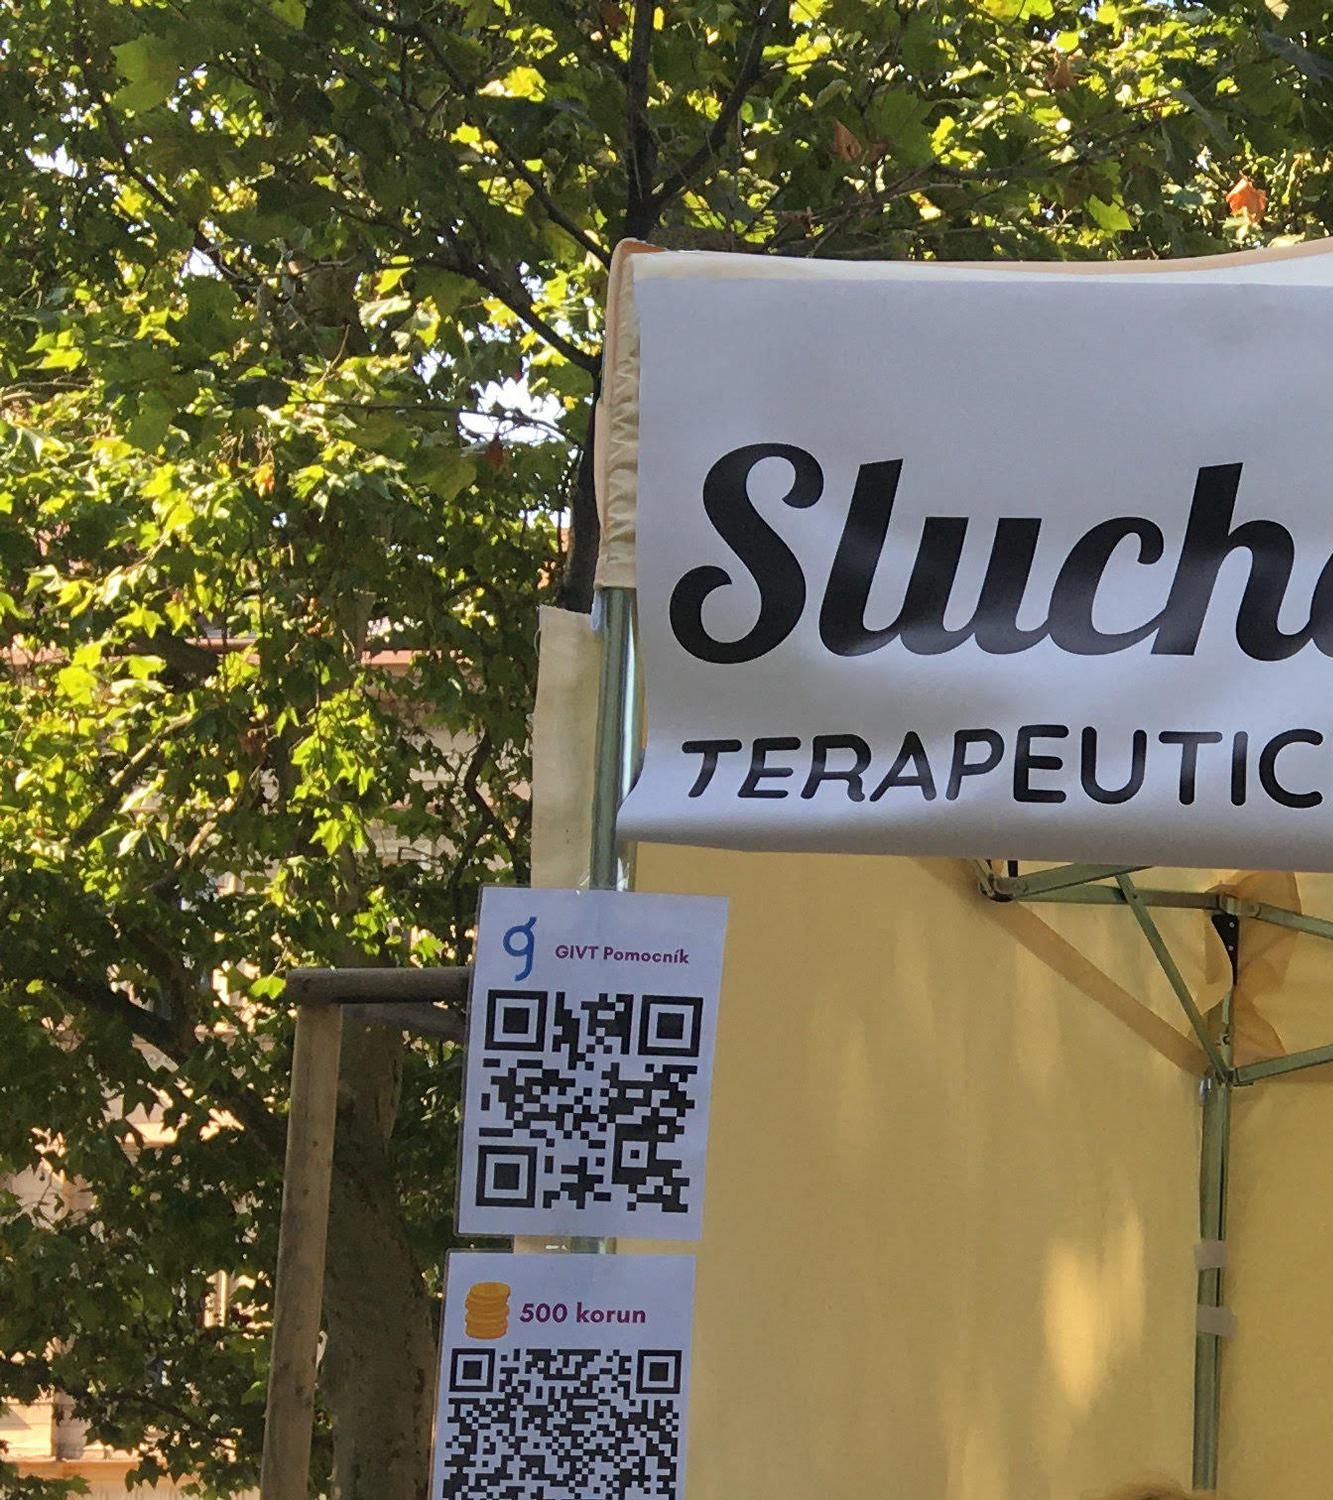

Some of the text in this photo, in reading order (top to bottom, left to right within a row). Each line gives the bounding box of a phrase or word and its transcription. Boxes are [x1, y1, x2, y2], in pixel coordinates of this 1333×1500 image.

[555, 944, 690, 965] GIVT Pomocník
[519, 1302, 647, 1324] 500 korun
